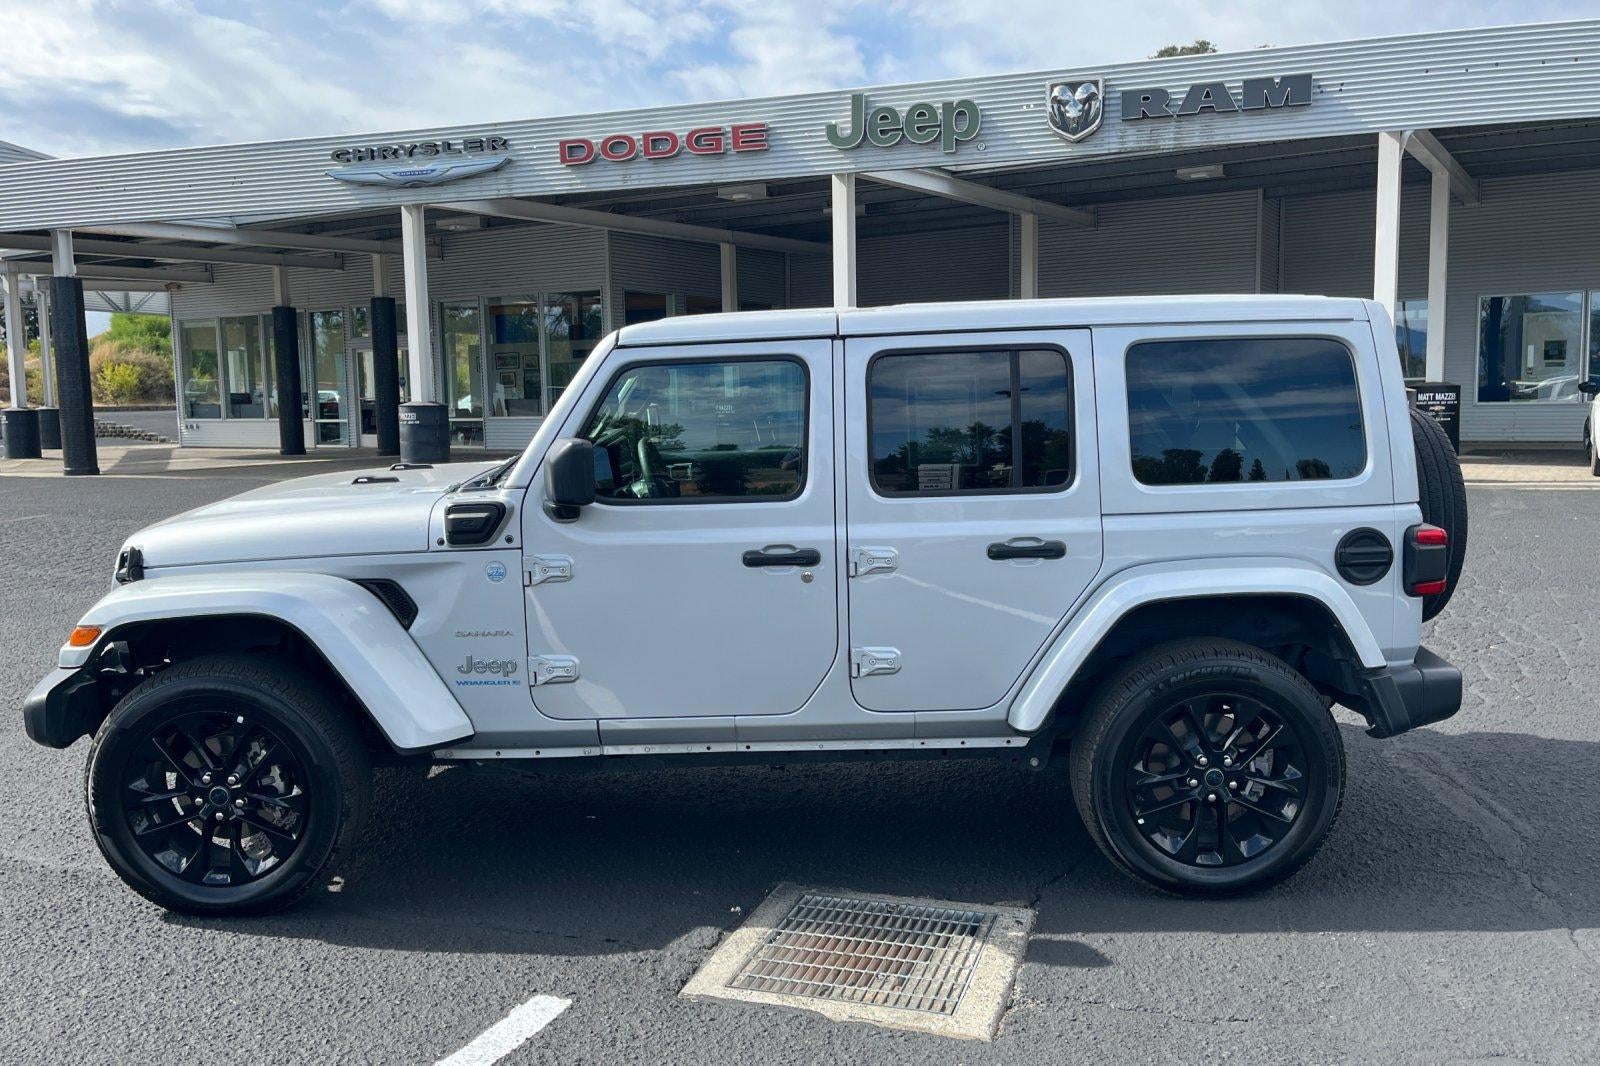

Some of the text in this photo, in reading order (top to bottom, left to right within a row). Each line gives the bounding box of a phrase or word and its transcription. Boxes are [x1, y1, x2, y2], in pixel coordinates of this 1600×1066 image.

[1121, 73, 1313, 120] RAM
[825, 92, 981, 152] Jeep
[330, 135, 511, 164] CHRYSLER
[559, 122, 769, 166] DODGE
[1418, 392, 1434, 401] MATT
[455, 630, 513, 638] SAHARA
[457, 655, 517, 678] Jeep
